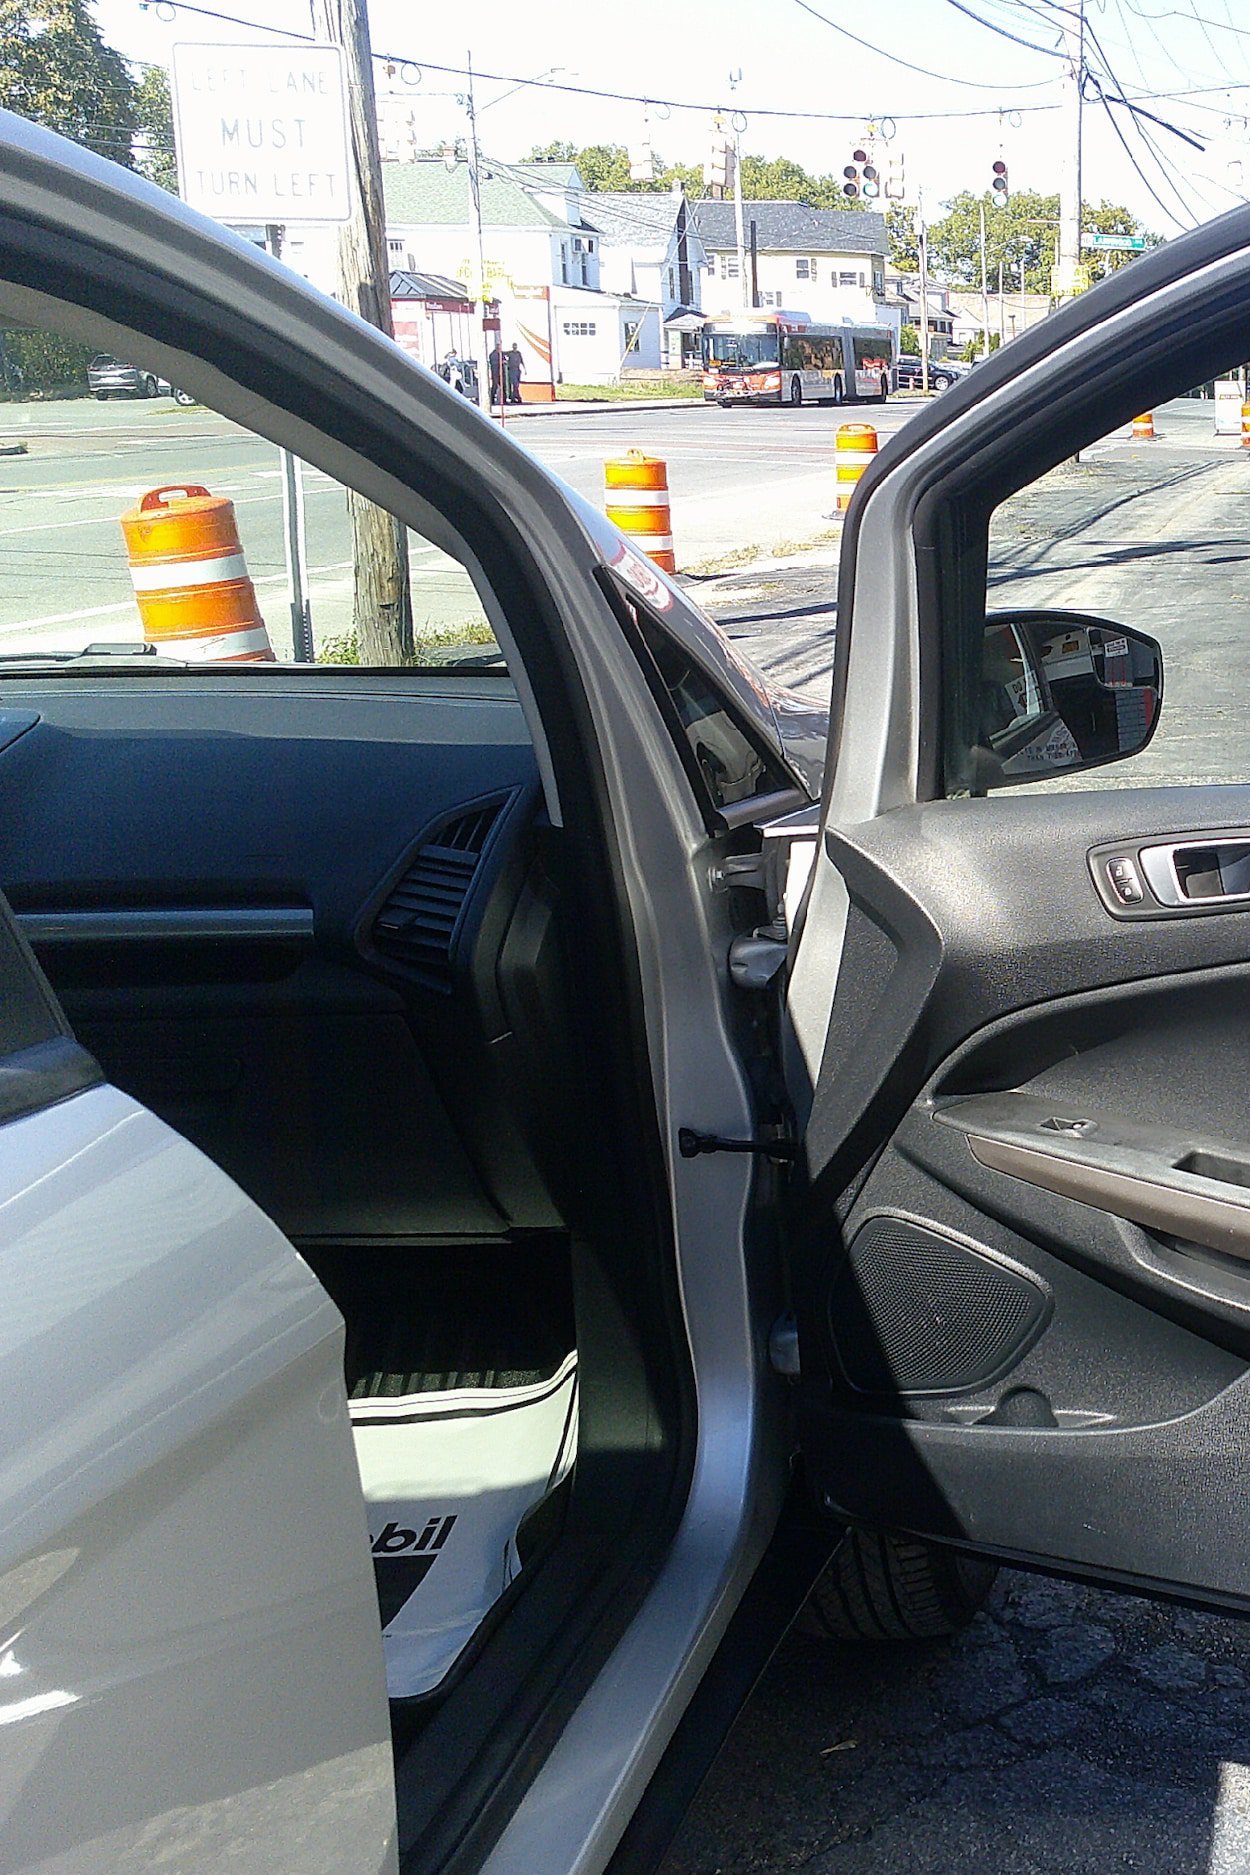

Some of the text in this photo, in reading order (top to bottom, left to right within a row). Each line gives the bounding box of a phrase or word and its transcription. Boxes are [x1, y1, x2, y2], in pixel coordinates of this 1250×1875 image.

[191, 69, 329, 95] LEFT LANE
[220, 117, 306, 149] MUST
[196, 170, 336, 198] TURN LEFT
[370, 1514, 458, 1553] bil
